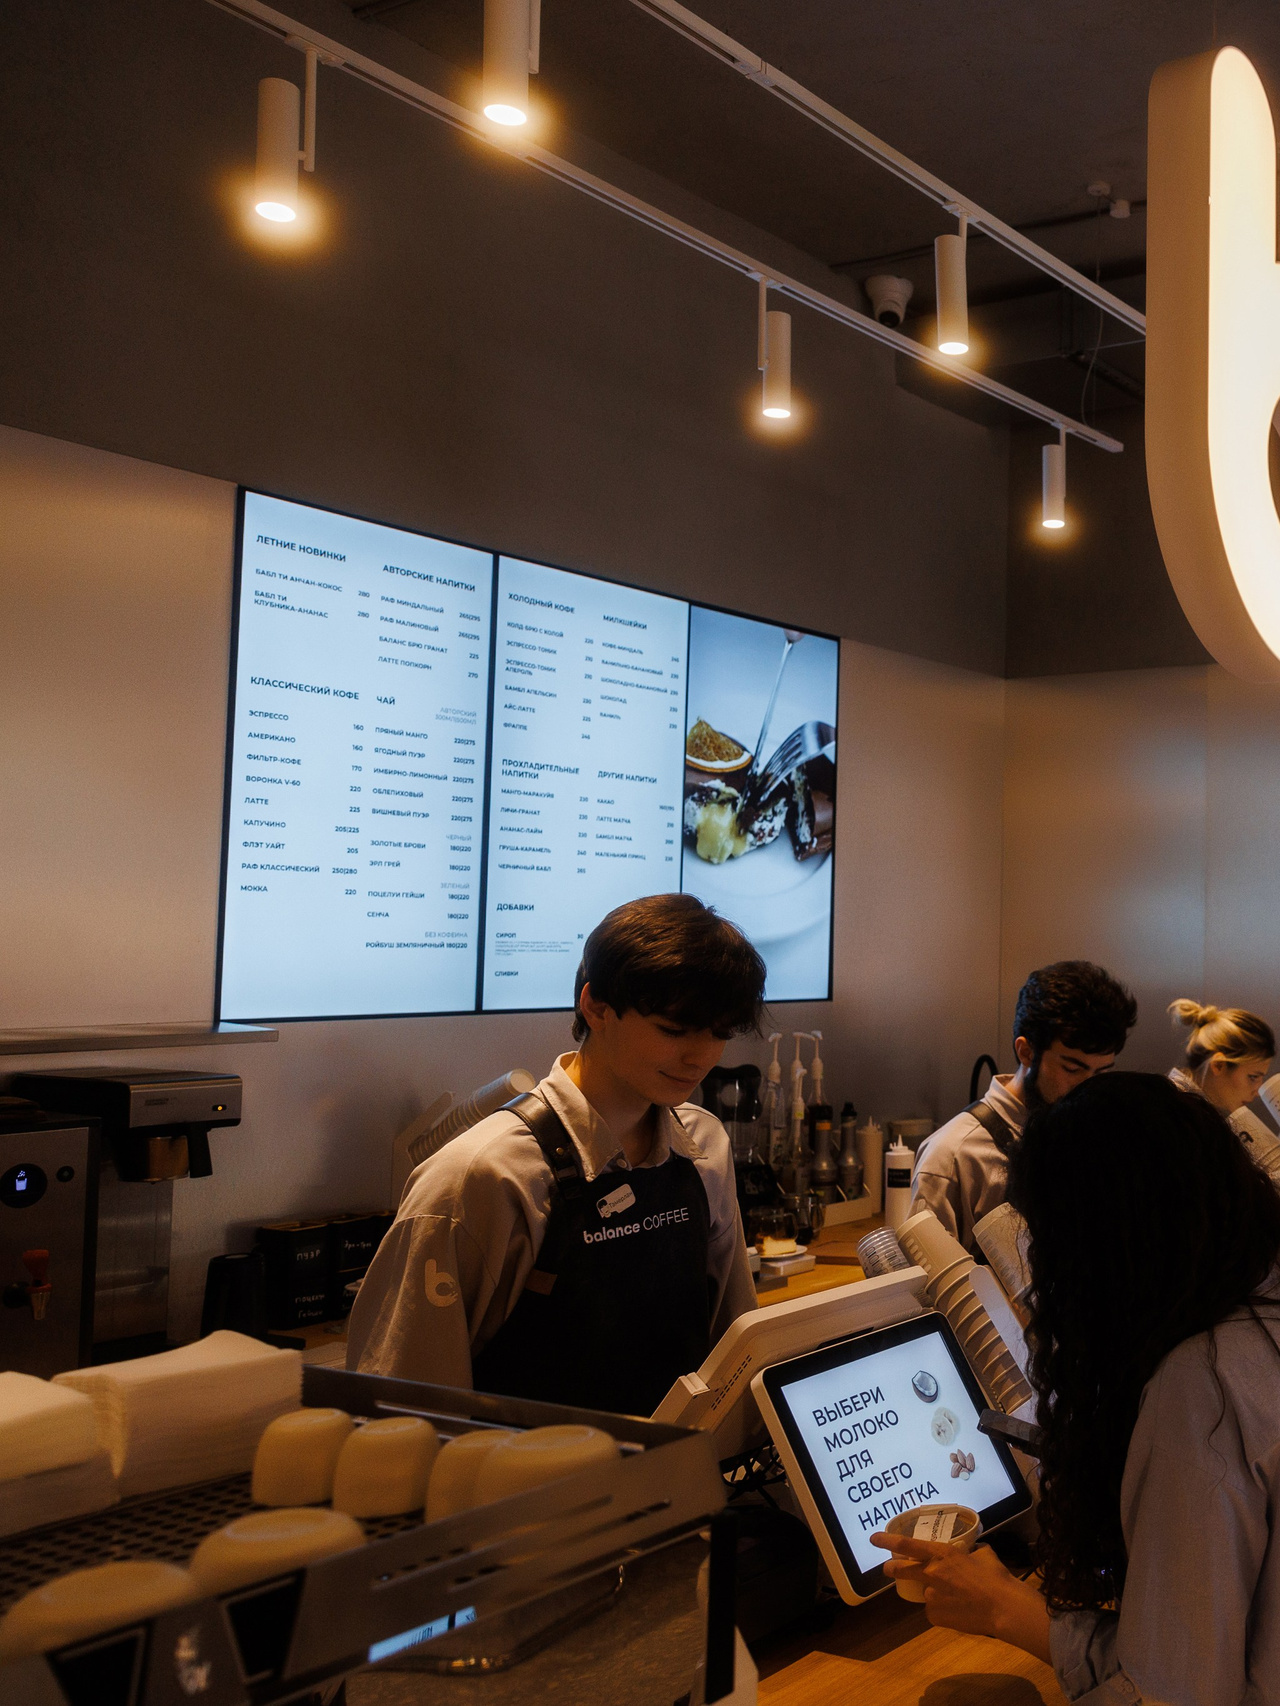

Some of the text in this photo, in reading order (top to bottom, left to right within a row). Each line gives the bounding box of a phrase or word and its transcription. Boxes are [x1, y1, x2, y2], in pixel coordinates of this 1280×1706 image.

[256, 534, 346, 562] ЛЕТНИЕ НОВИНКИ
[255, 568, 276, 577] БАБЛ
[289, 576, 342, 592] АНЧАН-КОКОС
[382, 564, 475, 592] АВТОРСКИЕ НАПИТКИ
[254, 590, 275, 599] БАБЛ
[358, 590, 370, 598] 280
[254, 598, 328, 618] КЛУБНИКА-АНАНАС
[380, 595, 444, 613] РАФ МИНДАЛЬНЫЙ
[508, 592, 574, 613] ХОЛОДНЫЙ КОФЕ
[357, 610, 369, 618] 280
[379, 615, 439, 632] РАФ МАЛИНОВЫЙ
[603, 615, 647, 629] МИЛКШЕЙКИ
[379, 635, 447, 653] БАЛАНС БРЮ ГРАНАТ
[377, 656, 432, 670] ЛАТТЕ ПОПКОРН
[505, 666, 533, 675] АПЕРОЛЬ
[250, 676, 359, 700] КЛАССИЧЕСКИЙ КОФЕ
[504, 684, 557, 697] БАМБЛ АПЕЛЬСИН
[376, 696, 395, 705] ЧАЙ
[248, 709, 289, 721] ЭСПРЕССО
[440, 707, 477, 717] АВТОРСКИЙ
[353, 723, 364, 731] 160
[503, 722, 527, 730] ФРАППЕ
[247, 731, 296, 743] АМЕРИКАНО
[375, 726, 428, 739] ПРЯНЫЙ МАНГО
[374, 747, 407, 756] ЯГОДНЫЙ
[246, 753, 301, 765] ФИЛЬТР-КОФЕ
[502, 758, 579, 774] ПРОХЛАДИТЕЛЬНЫЕ
[245, 775, 282, 784] ВОРОНКА
[373, 768, 448, 780] ИМБИРНО-ЛИМОННЫЙ
[501, 769, 538, 779] НАПИТКИ
[597, 770, 657, 783] ДРУГИЕ НАПИТКИ
[372, 787, 423, 798] ОБЛЕПИХОВЫЙ
[501, 788, 554, 798] МАНГО-МАРАКУЙЯ
[244, 797, 268, 805] ЛАТТЕ
[371, 808, 411, 816] ВИШНЕВЫЙ
[500, 806, 540, 815] ЛИЧИ-ГРАНАТ
[243, 819, 286, 828] КАПУЧИНО
[499, 826, 543, 834] АНАНАС-ЛАЙМ
[498, 844, 551, 853] ГРУША-КАРАМЕЛЬ
[259, 864, 319, 872] КЛАССИЧЕСКИЙ
[496, 903, 534, 911] ДОБАВКИ
[583, 1207, 690, 1244] balance COFFEE
[812, 1386, 885, 1427] ВЫБЕРИ
[823, 1409, 899, 1452] МОЛОКО
[836, 1449, 874, 1482] ДЛЯ
[847, 1462, 913, 1503] СВОЕГО
[858, 1481, 940, 1531] НАПИТКА
